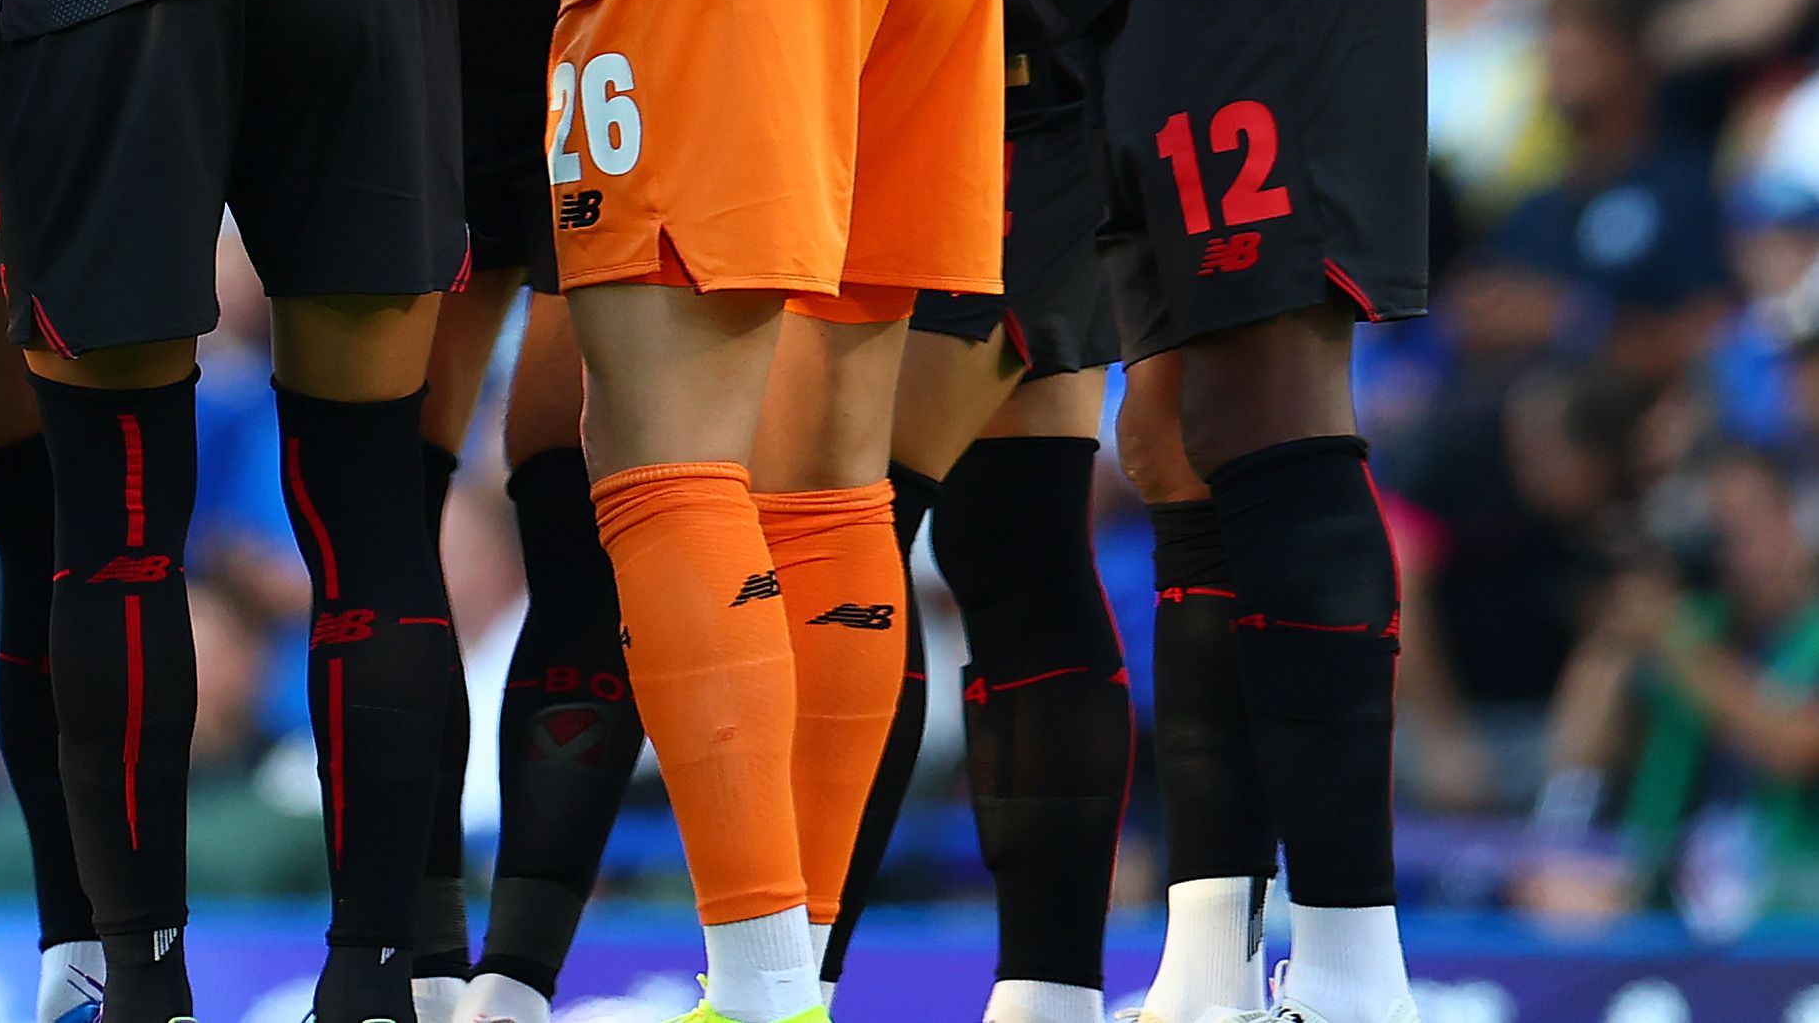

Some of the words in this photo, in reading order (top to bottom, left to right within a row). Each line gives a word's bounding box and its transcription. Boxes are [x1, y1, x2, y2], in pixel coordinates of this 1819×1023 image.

[547, 53, 642, 185] 26
[1155, 100, 1293, 235] 12
[545, 666, 635, 702] B0
